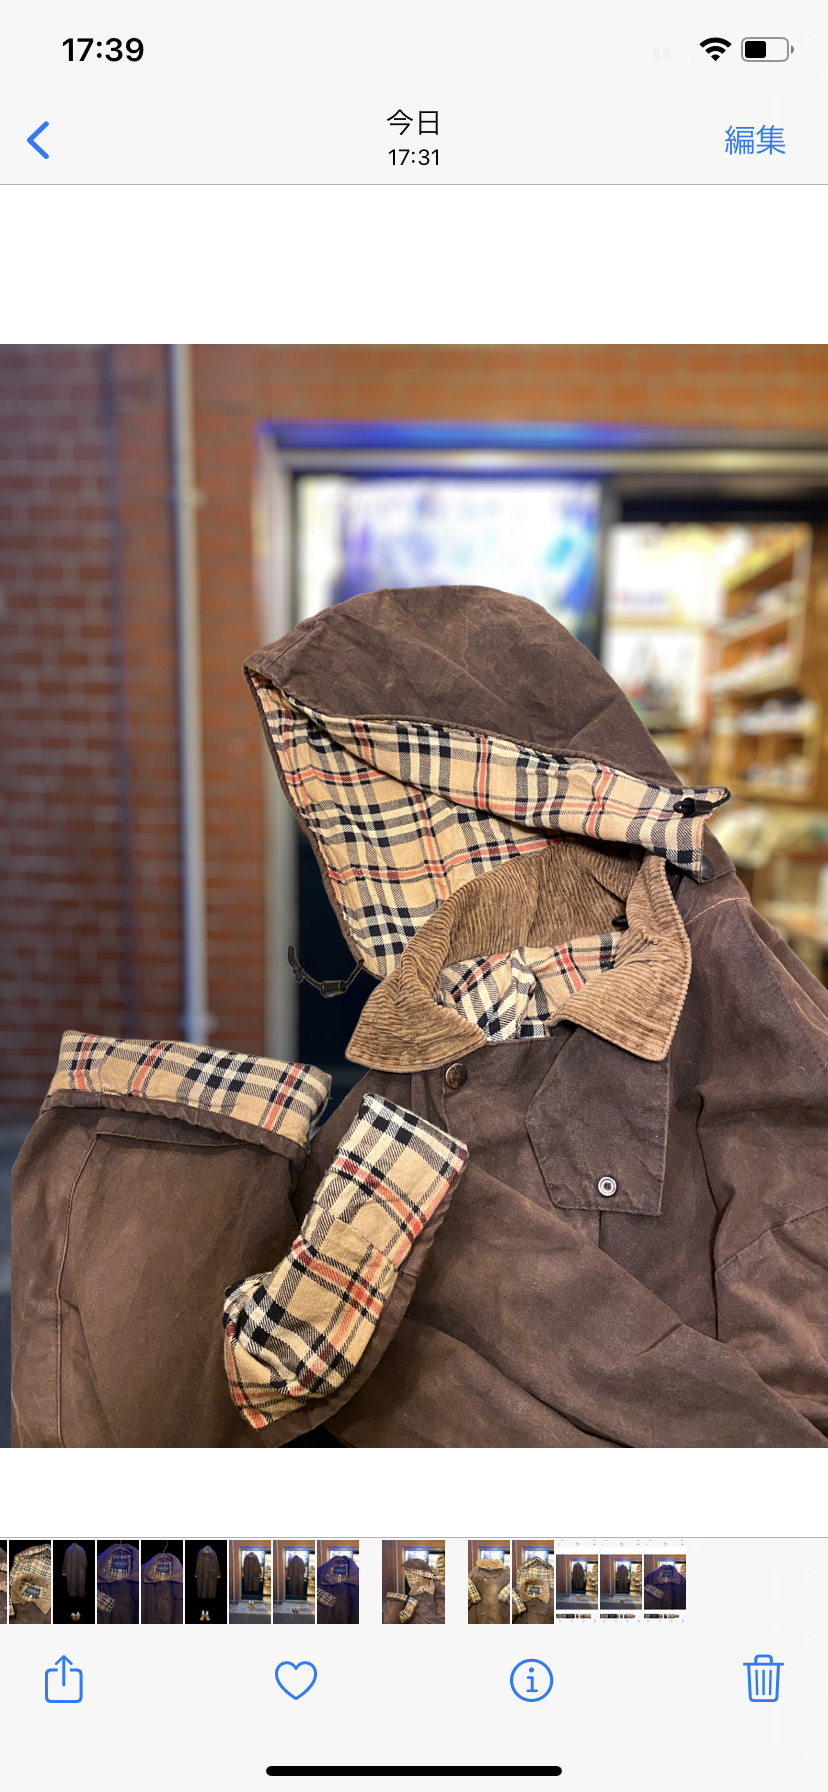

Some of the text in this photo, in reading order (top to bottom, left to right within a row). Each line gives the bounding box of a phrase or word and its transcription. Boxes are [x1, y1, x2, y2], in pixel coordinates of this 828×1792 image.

[62, 37, 145, 63] 17:39
[386, 109, 440, 136] 今日
[724, 124, 786, 156] 編集
[388, 148, 440, 166] 17:31
